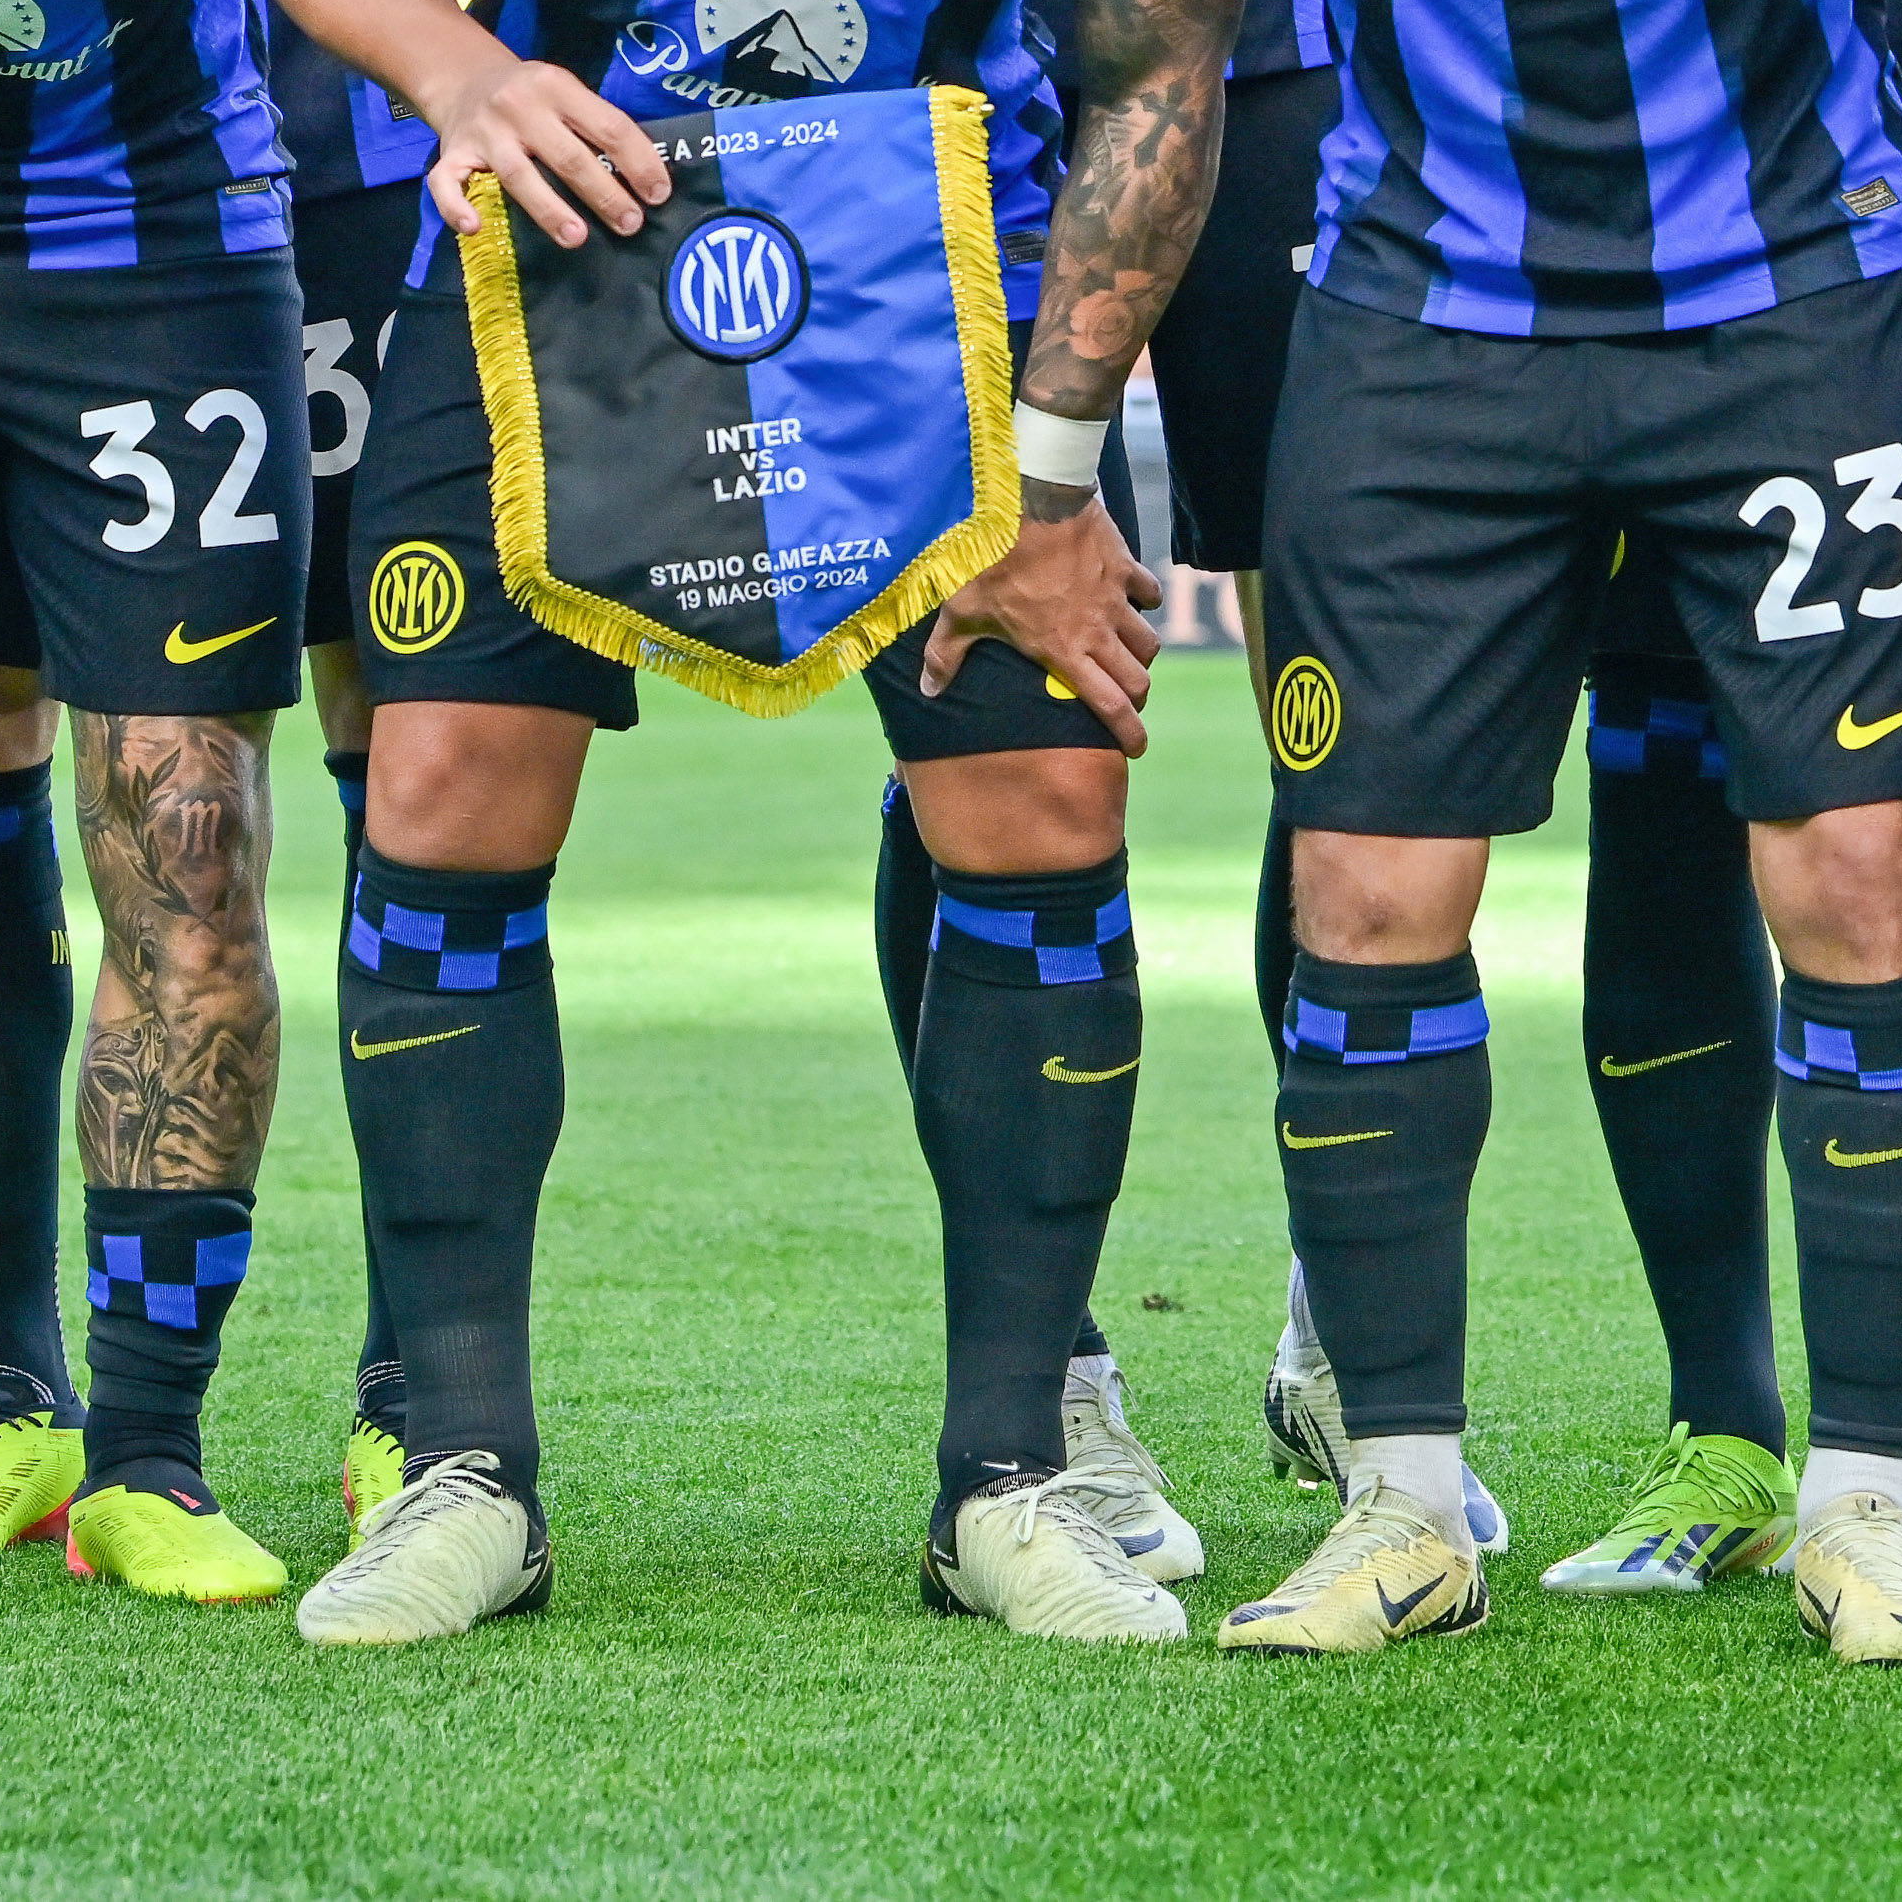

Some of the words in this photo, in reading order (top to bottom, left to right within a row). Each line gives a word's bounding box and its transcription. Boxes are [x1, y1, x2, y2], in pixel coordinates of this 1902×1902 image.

[674, 139, 693, 162] A
[700, 131, 760, 158] 2023
[781, 119, 839, 146] 2024
[303, 308, 398, 478] 3
[704, 417, 803, 455] INTER
[79, 387, 279, 554] 32
[712, 466, 808, 503] LAZIO
[649, 555, 746, 588] STADIO
[751, 537, 892, 574] G.MEAZZA
[675, 587, 702, 612] 19
[706, 573, 808, 609] MAGGIO
[814, 564, 870, 590] 2024
